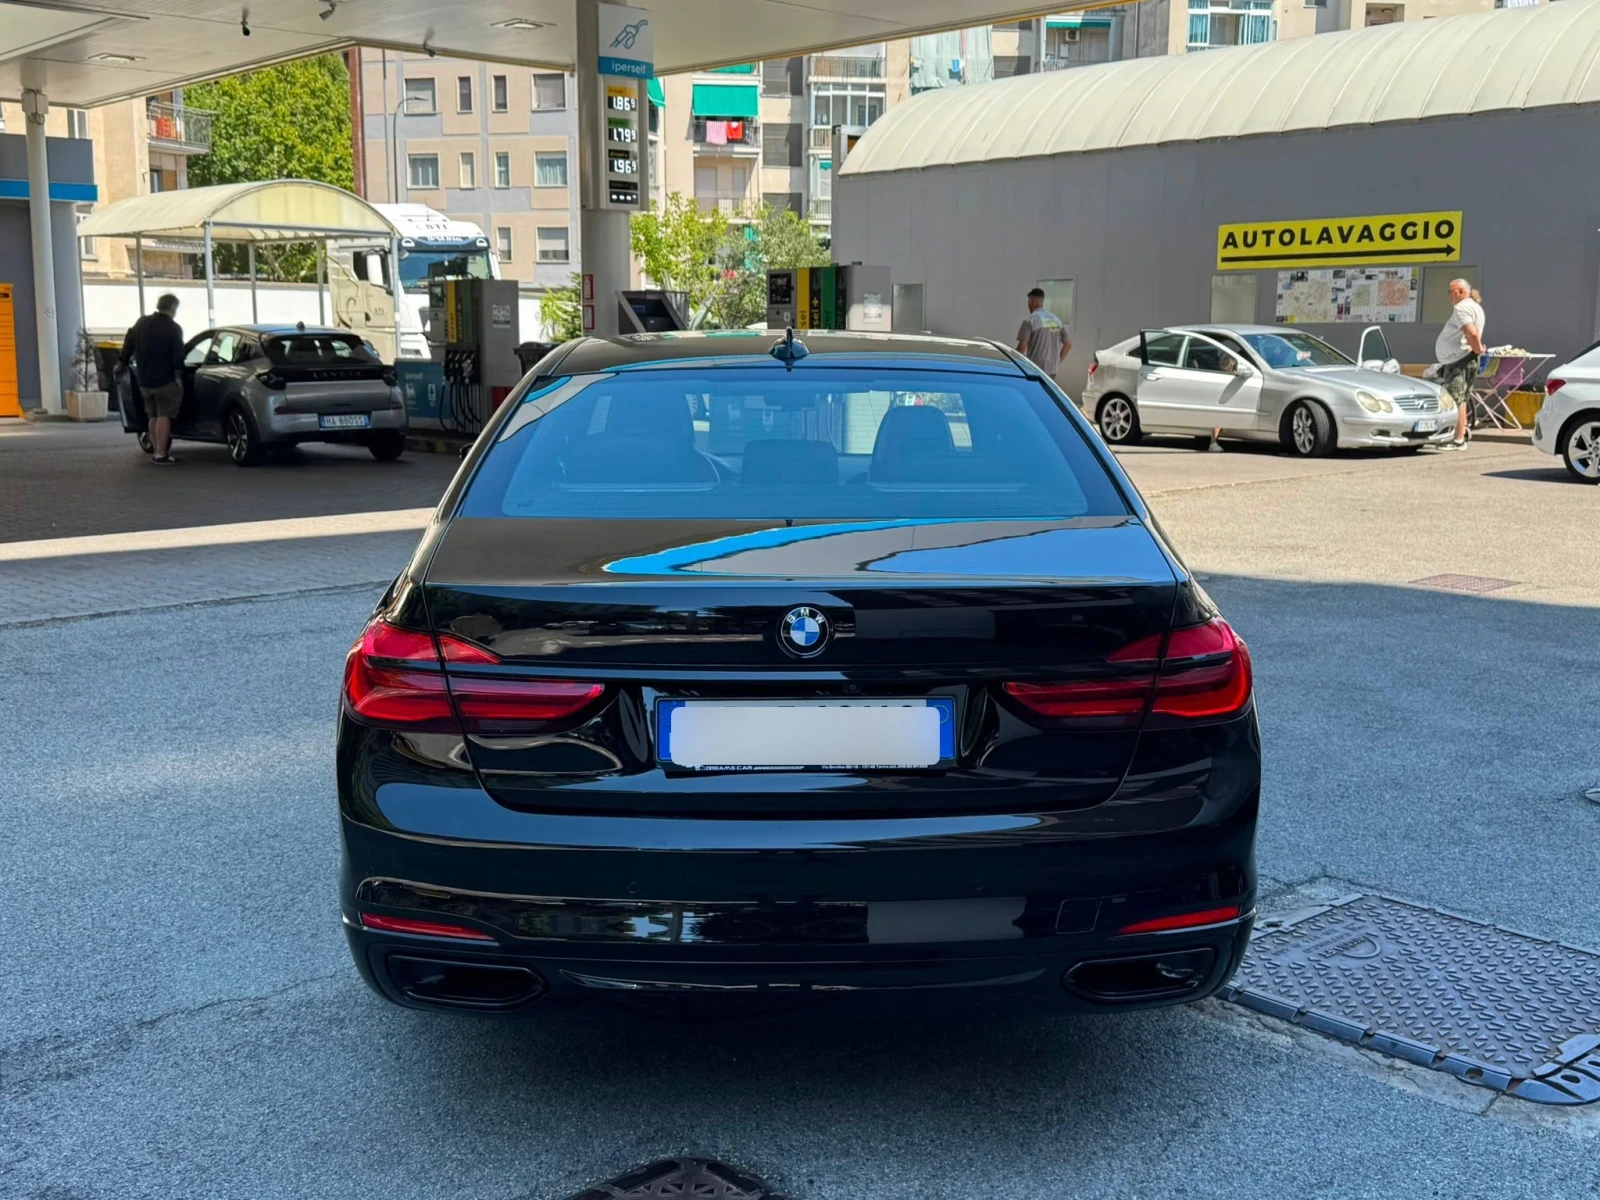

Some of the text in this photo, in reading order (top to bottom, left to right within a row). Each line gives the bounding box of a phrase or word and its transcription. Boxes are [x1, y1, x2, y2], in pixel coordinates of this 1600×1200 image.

[611, 60, 646, 74] iperself
[1222, 219, 1455, 249] AUTOLAVAGGIO
[786, 608, 825, 624] BMW
